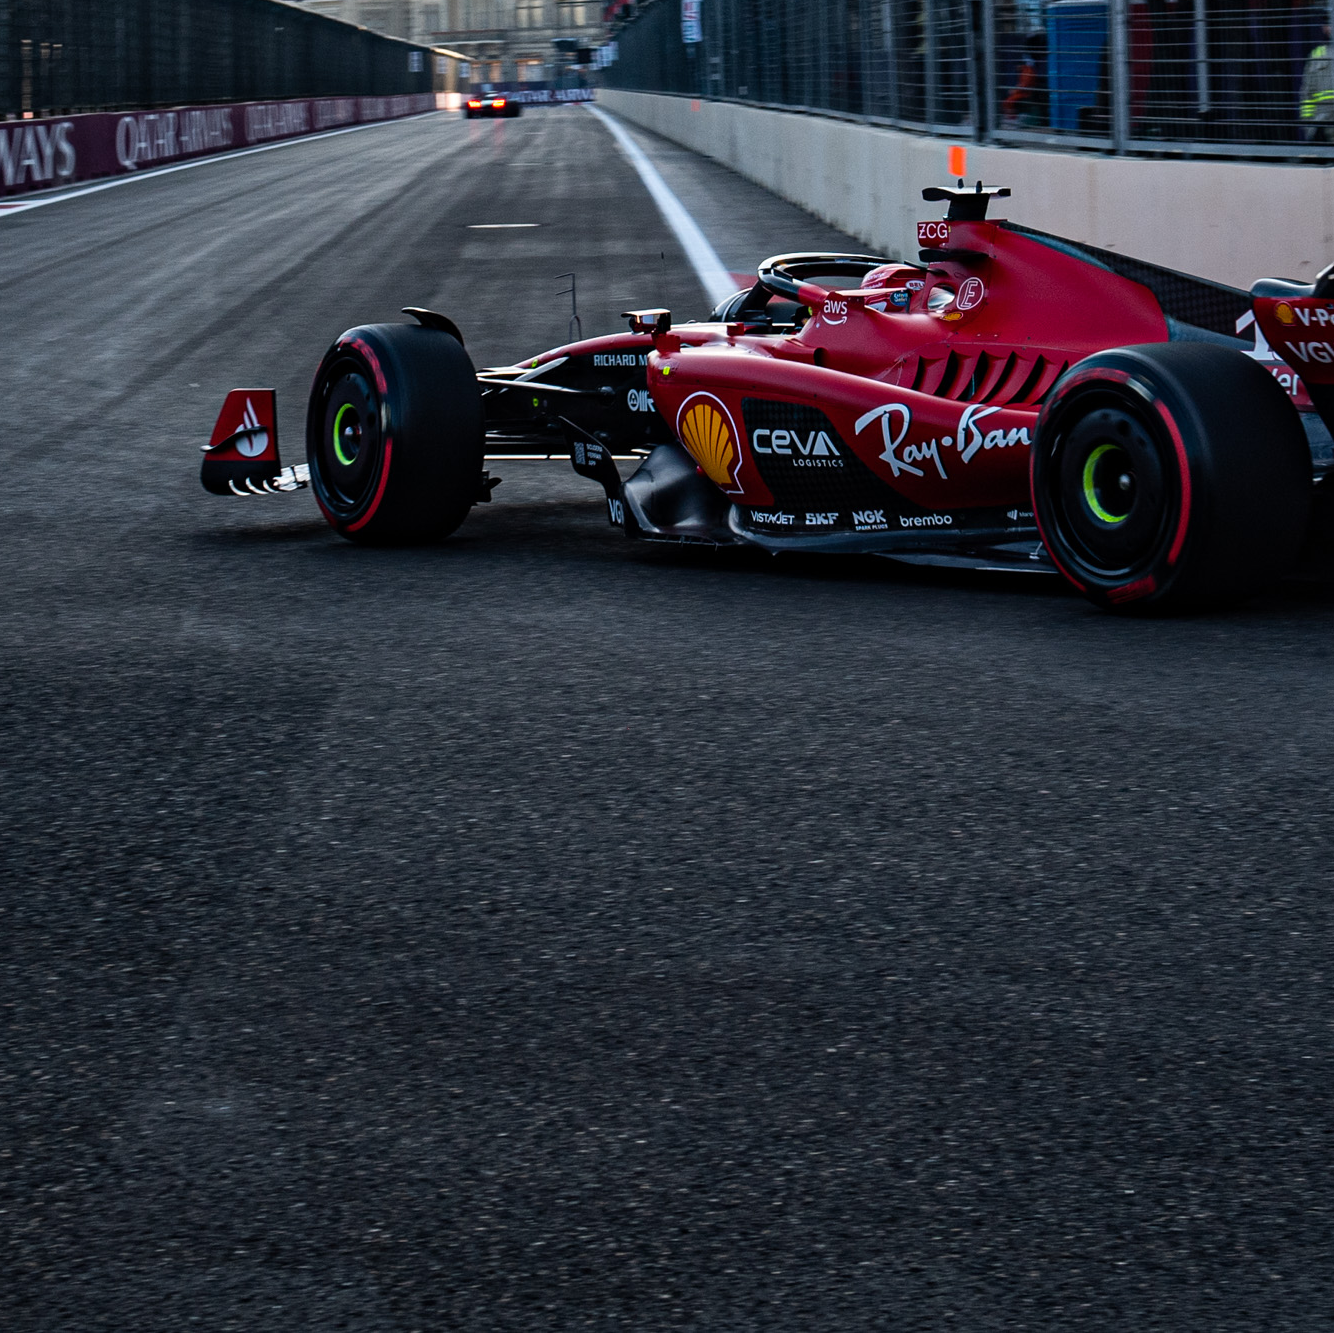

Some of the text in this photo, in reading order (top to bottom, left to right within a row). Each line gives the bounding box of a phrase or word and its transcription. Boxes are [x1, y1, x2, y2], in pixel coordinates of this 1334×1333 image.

[823, 299, 848, 315] aws
[593, 354, 649, 366] RICHARD M
[793, 458, 844, 468] LOGISTICS
[805, 512, 839, 525] SKF
[852, 509, 887, 525] NGK
[899, 513, 953, 527] brembo
